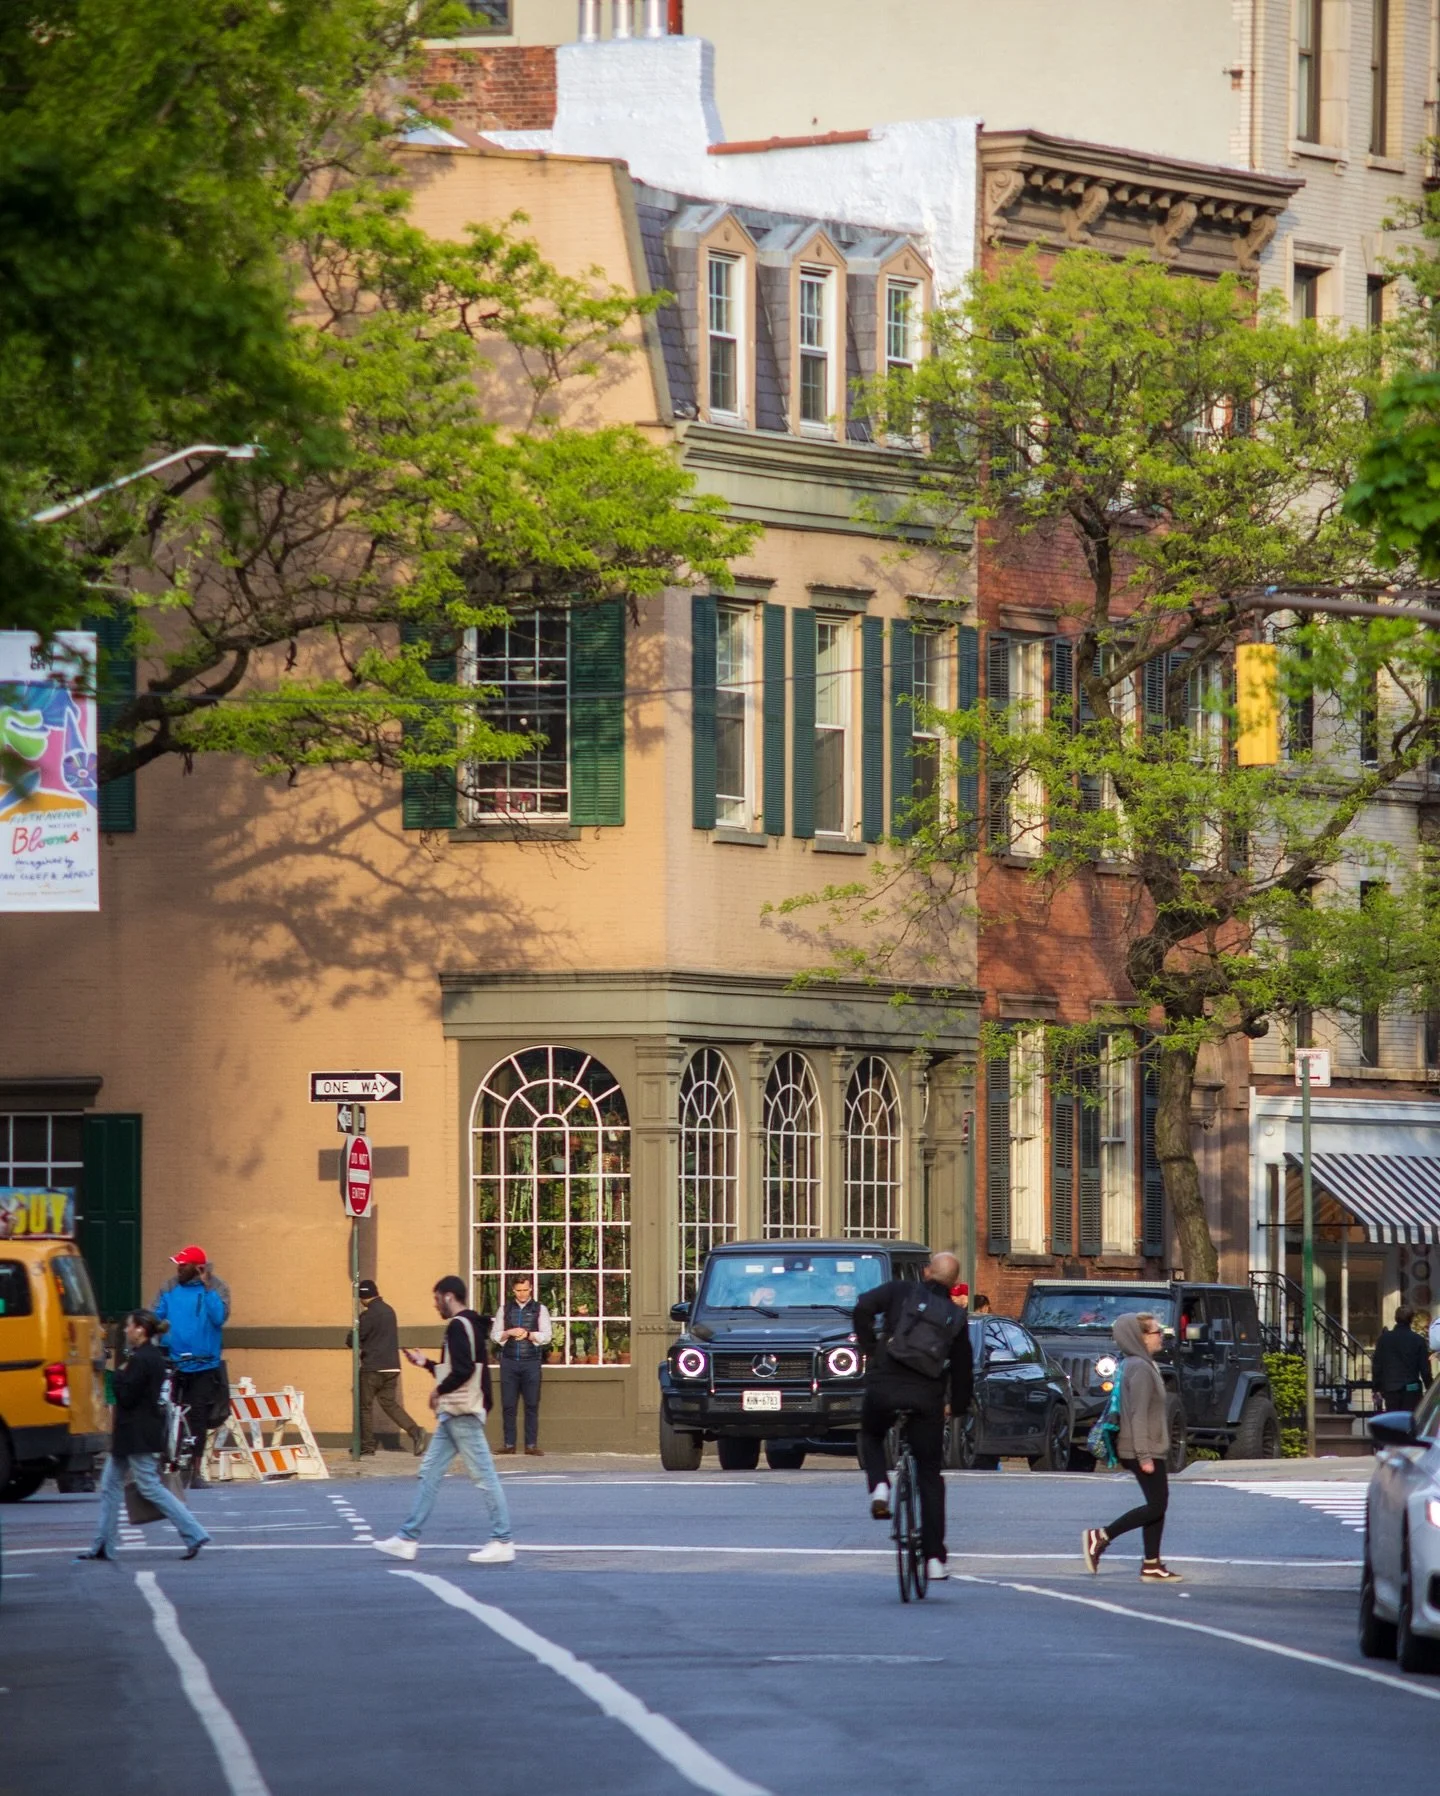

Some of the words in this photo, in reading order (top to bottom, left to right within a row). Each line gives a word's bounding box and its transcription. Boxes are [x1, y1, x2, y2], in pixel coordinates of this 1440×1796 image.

[12, 826, 80, 855] Blooms
[323, 1081, 349, 1093] ONE
[361, 1081, 387, 1093] WAY
[351, 1152, 358, 1165] DO
[359, 1153, 369, 1166] NOT
[351, 1187, 367, 1200] ENTER
